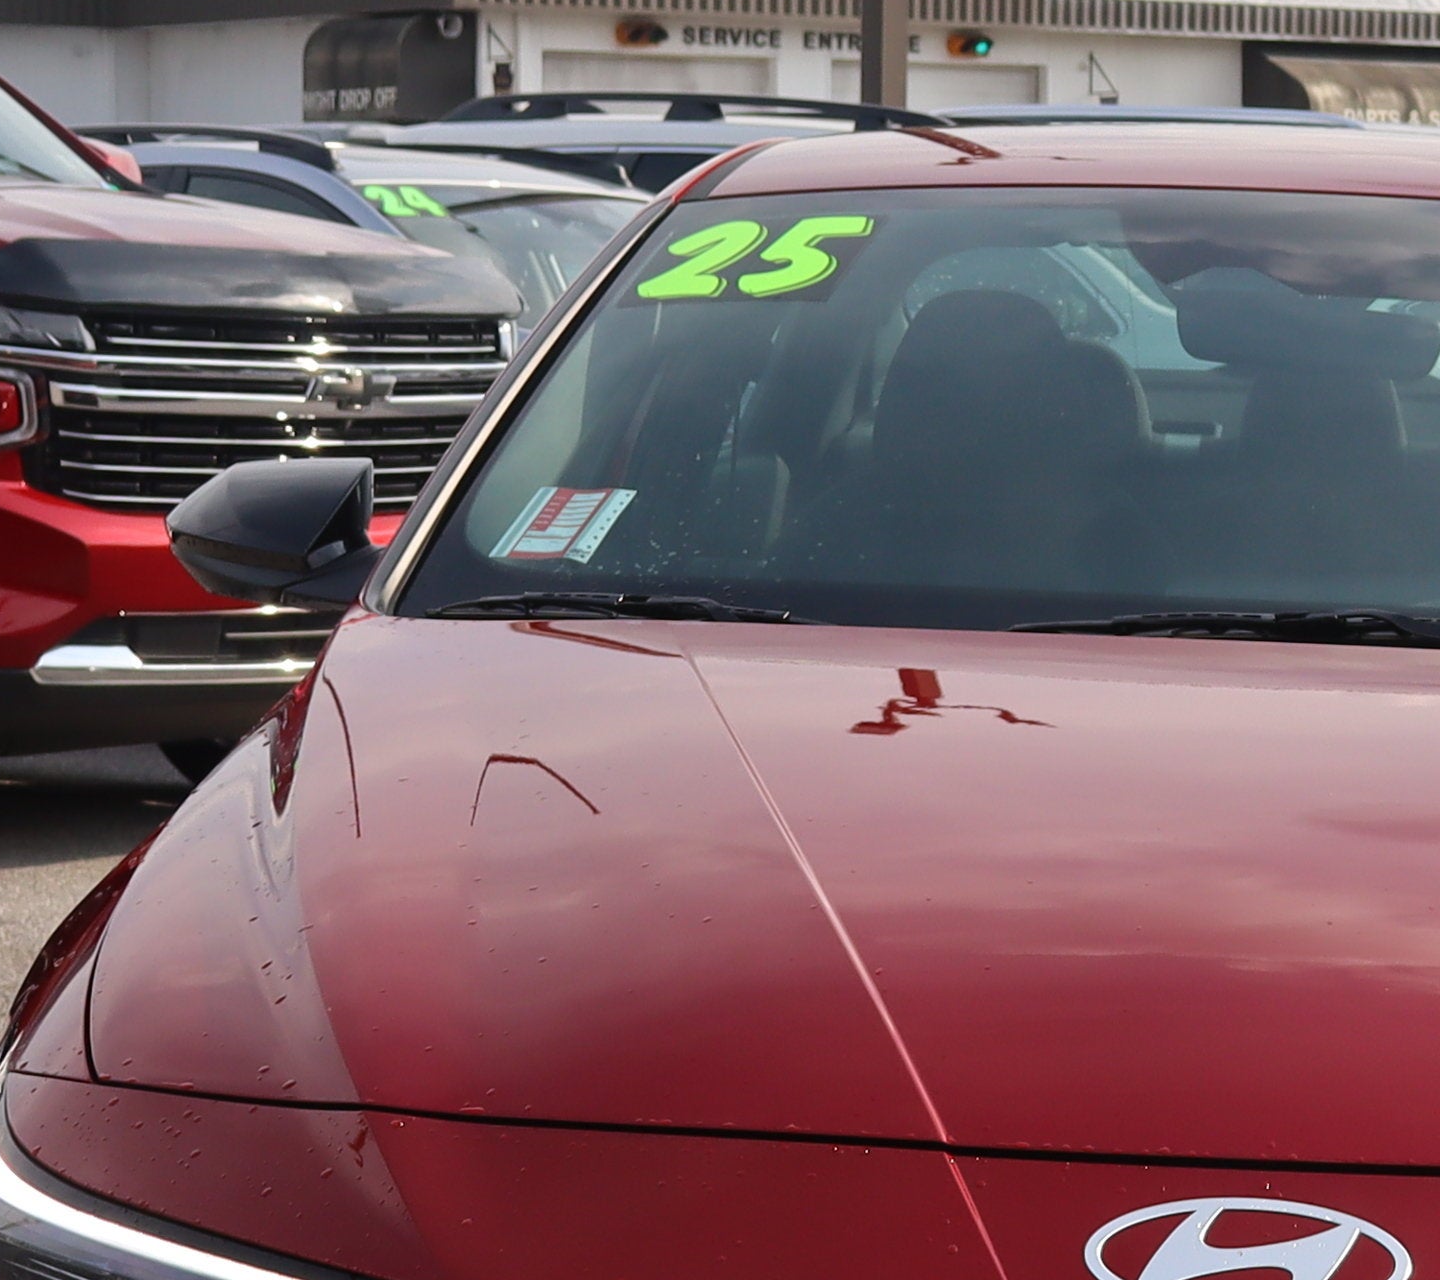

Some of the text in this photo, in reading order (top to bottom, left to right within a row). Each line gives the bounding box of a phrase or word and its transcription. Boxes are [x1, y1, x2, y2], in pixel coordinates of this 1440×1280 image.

[682, 26, 921, 54] SERVICE ENTRE
[363, 185, 447, 217] 24
[637, 216, 875, 299] 25
